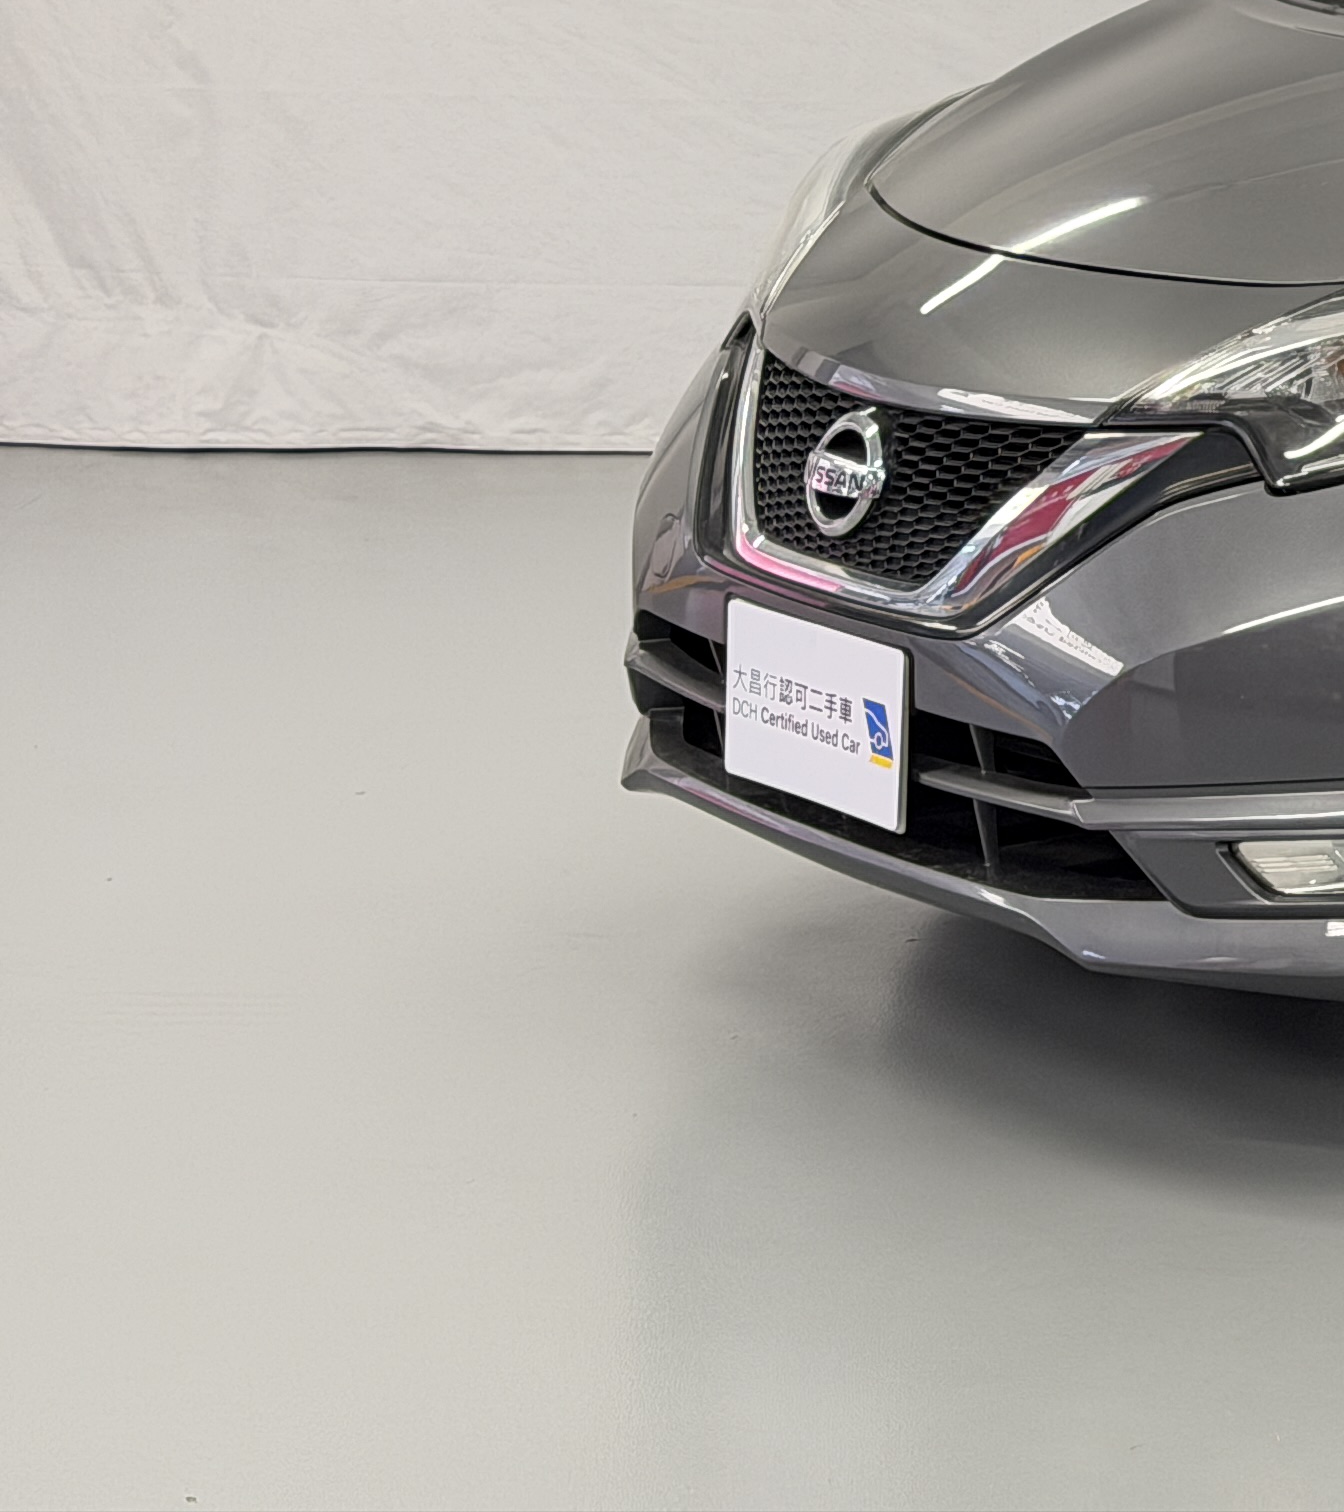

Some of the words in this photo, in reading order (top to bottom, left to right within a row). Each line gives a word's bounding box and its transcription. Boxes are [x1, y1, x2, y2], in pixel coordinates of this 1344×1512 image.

[814, 464, 867, 492] SSAN
[732, 663, 853, 724] 大昌行認可二手車
[732, 696, 758, 721] DCH
[760, 706, 809, 737] Certified
[811, 721, 839, 748] Used
[841, 732, 861, 755] Car
